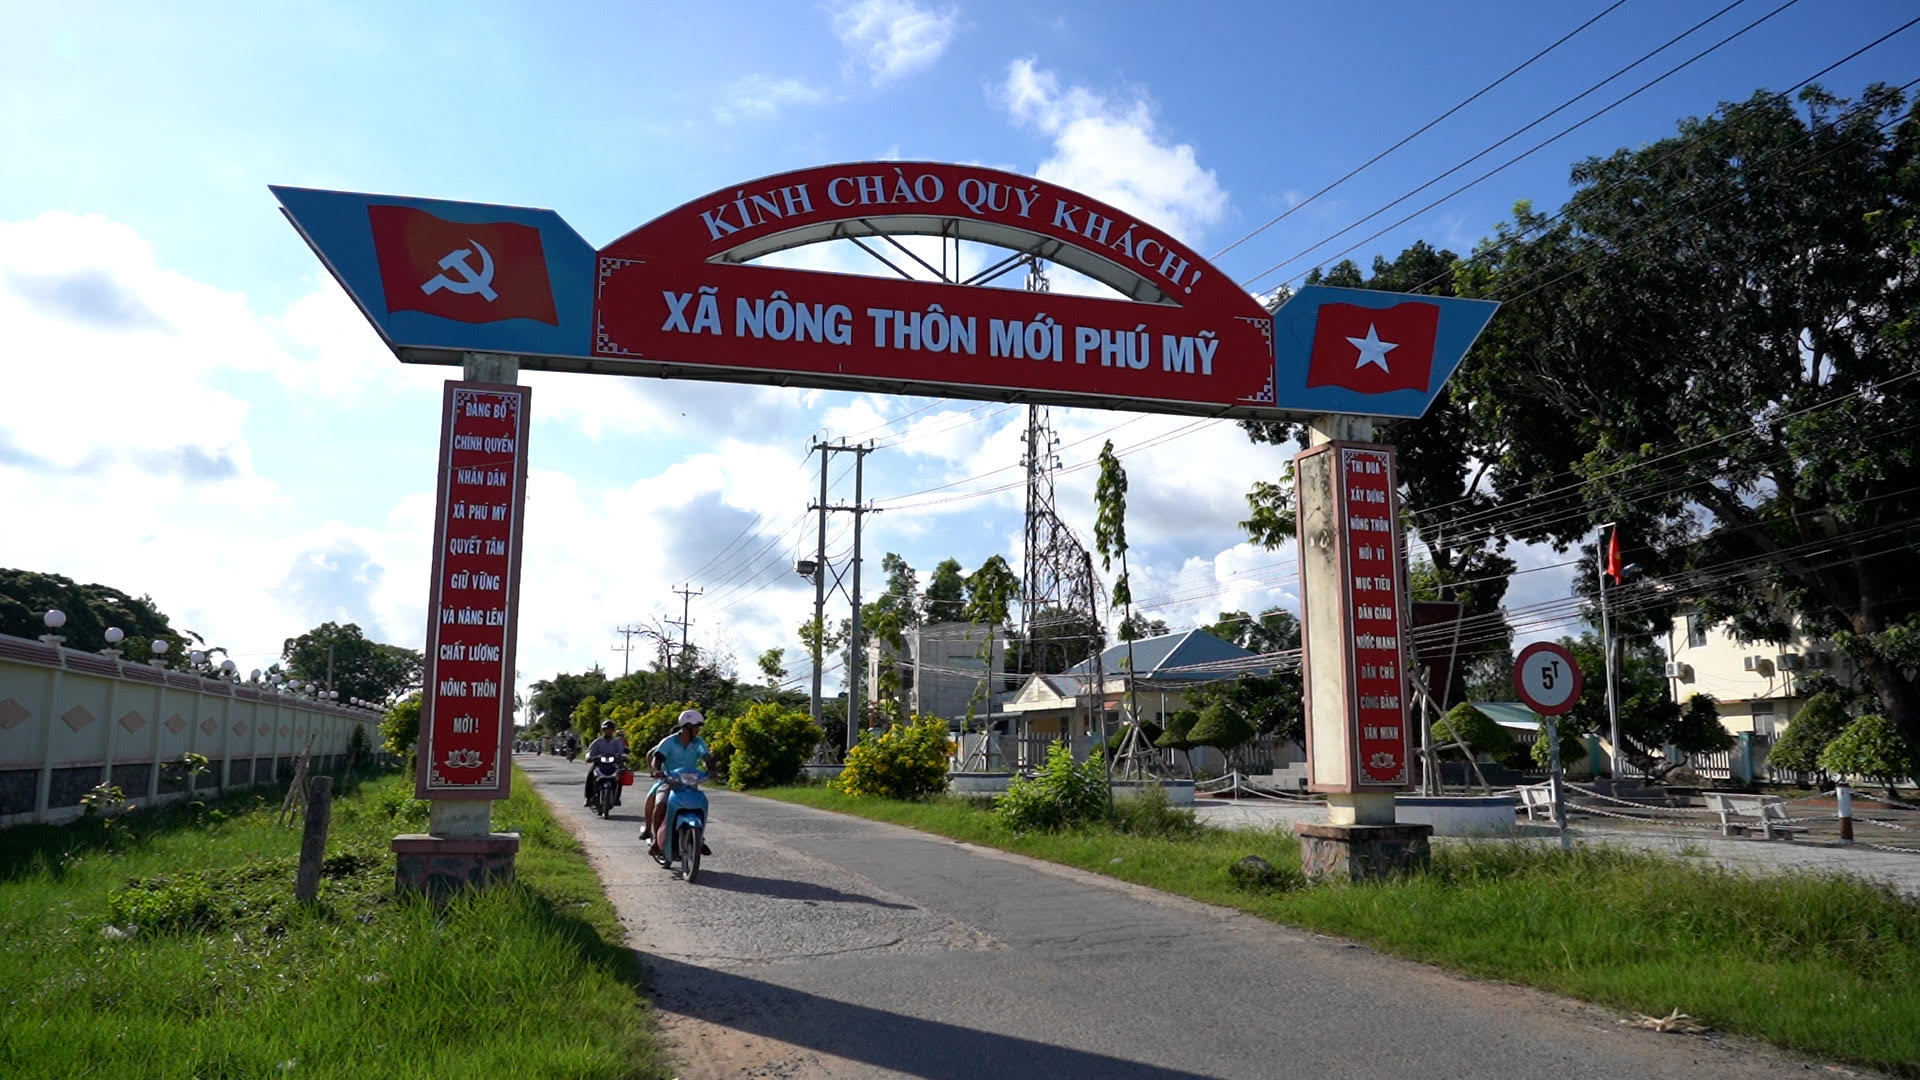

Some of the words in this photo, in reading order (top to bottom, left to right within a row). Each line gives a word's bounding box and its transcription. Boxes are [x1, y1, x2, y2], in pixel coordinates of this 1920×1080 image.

[698, 183, 816, 242] KÍNH
[827, 167, 945, 207] CHÀO
[958, 178, 1041, 219] QUÝ
[1051, 199, 1202, 295] KHÁCH!
[661, 285, 722, 336] XÃ
[735, 290, 852, 346] NÔNG
[867, 303, 977, 355] THÔN
[989, 312, 1063, 362] MỚI
[1075, 324, 1150, 370] PHÚ
[1162, 330, 1220, 375] MỸ
[493, 401, 507, 421] BỘ
[454, 432, 482, 451] CHÍNH
[484, 433, 514, 454] QUYỀN
[457, 466, 484, 485] NHÂN
[487, 468, 507, 487] DÂN
[1350, 485, 1364, 501] XÂY
[453, 500, 465, 519] XÃ
[468, 502, 489, 520] PHÚ
[492, 503, 507, 520] MỸ
[450, 535, 482, 556] QUYẾT
[486, 537, 505, 555] TÂM
[451, 570, 470, 589] GIỮ
[472, 571, 500, 590] VỮNG
[1355, 576, 1372, 592] MỤC
[1374, 574, 1391, 591] TIÊU
[442, 604, 455, 624] VÀ
[457, 606, 483, 625] NÂNG
[486, 607, 504, 626] LÊN
[1357, 603, 1373, 619] DÂN
[1374, 603, 1392, 620] GIÀU
[440, 640, 465, 660] CHẤT
[469, 643, 500, 664] LƯỢNG
[1379, 661, 1395, 679] CHỦ
[440, 677, 467, 697] NÔNG
[471, 678, 497, 698] THÔN
